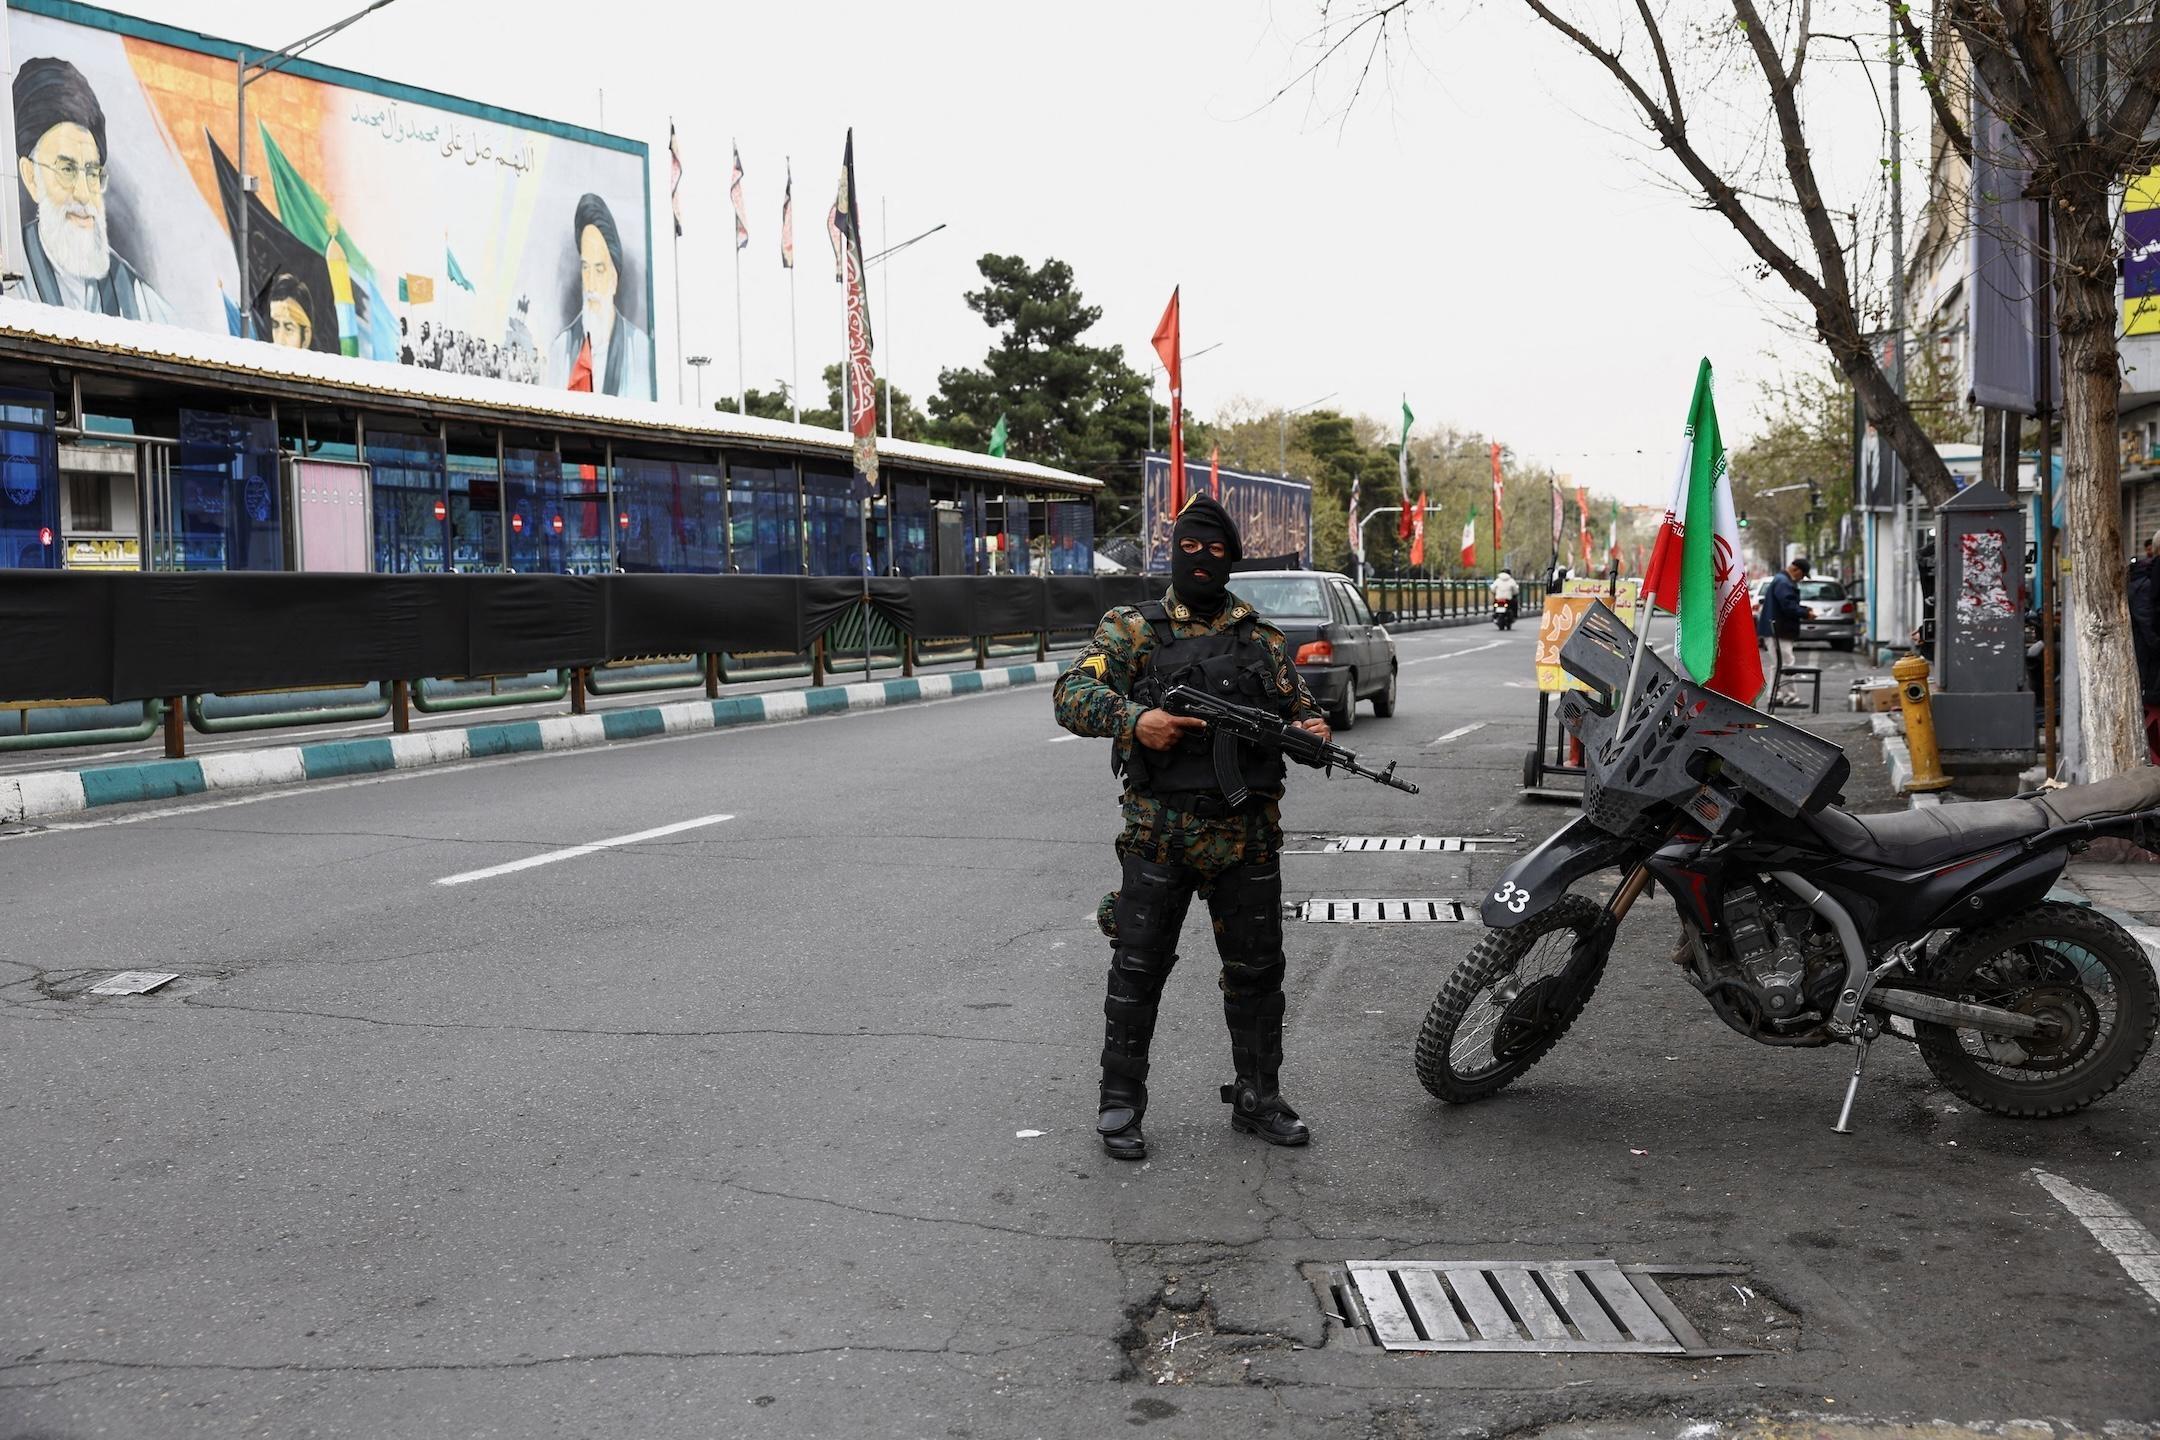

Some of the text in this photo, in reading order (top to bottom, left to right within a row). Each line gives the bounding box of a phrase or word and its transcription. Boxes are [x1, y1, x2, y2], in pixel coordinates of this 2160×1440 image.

[351, 103, 385, 127] محمد
[406, 119, 440, 142] محمد
[1494, 881, 1530, 913] 33
